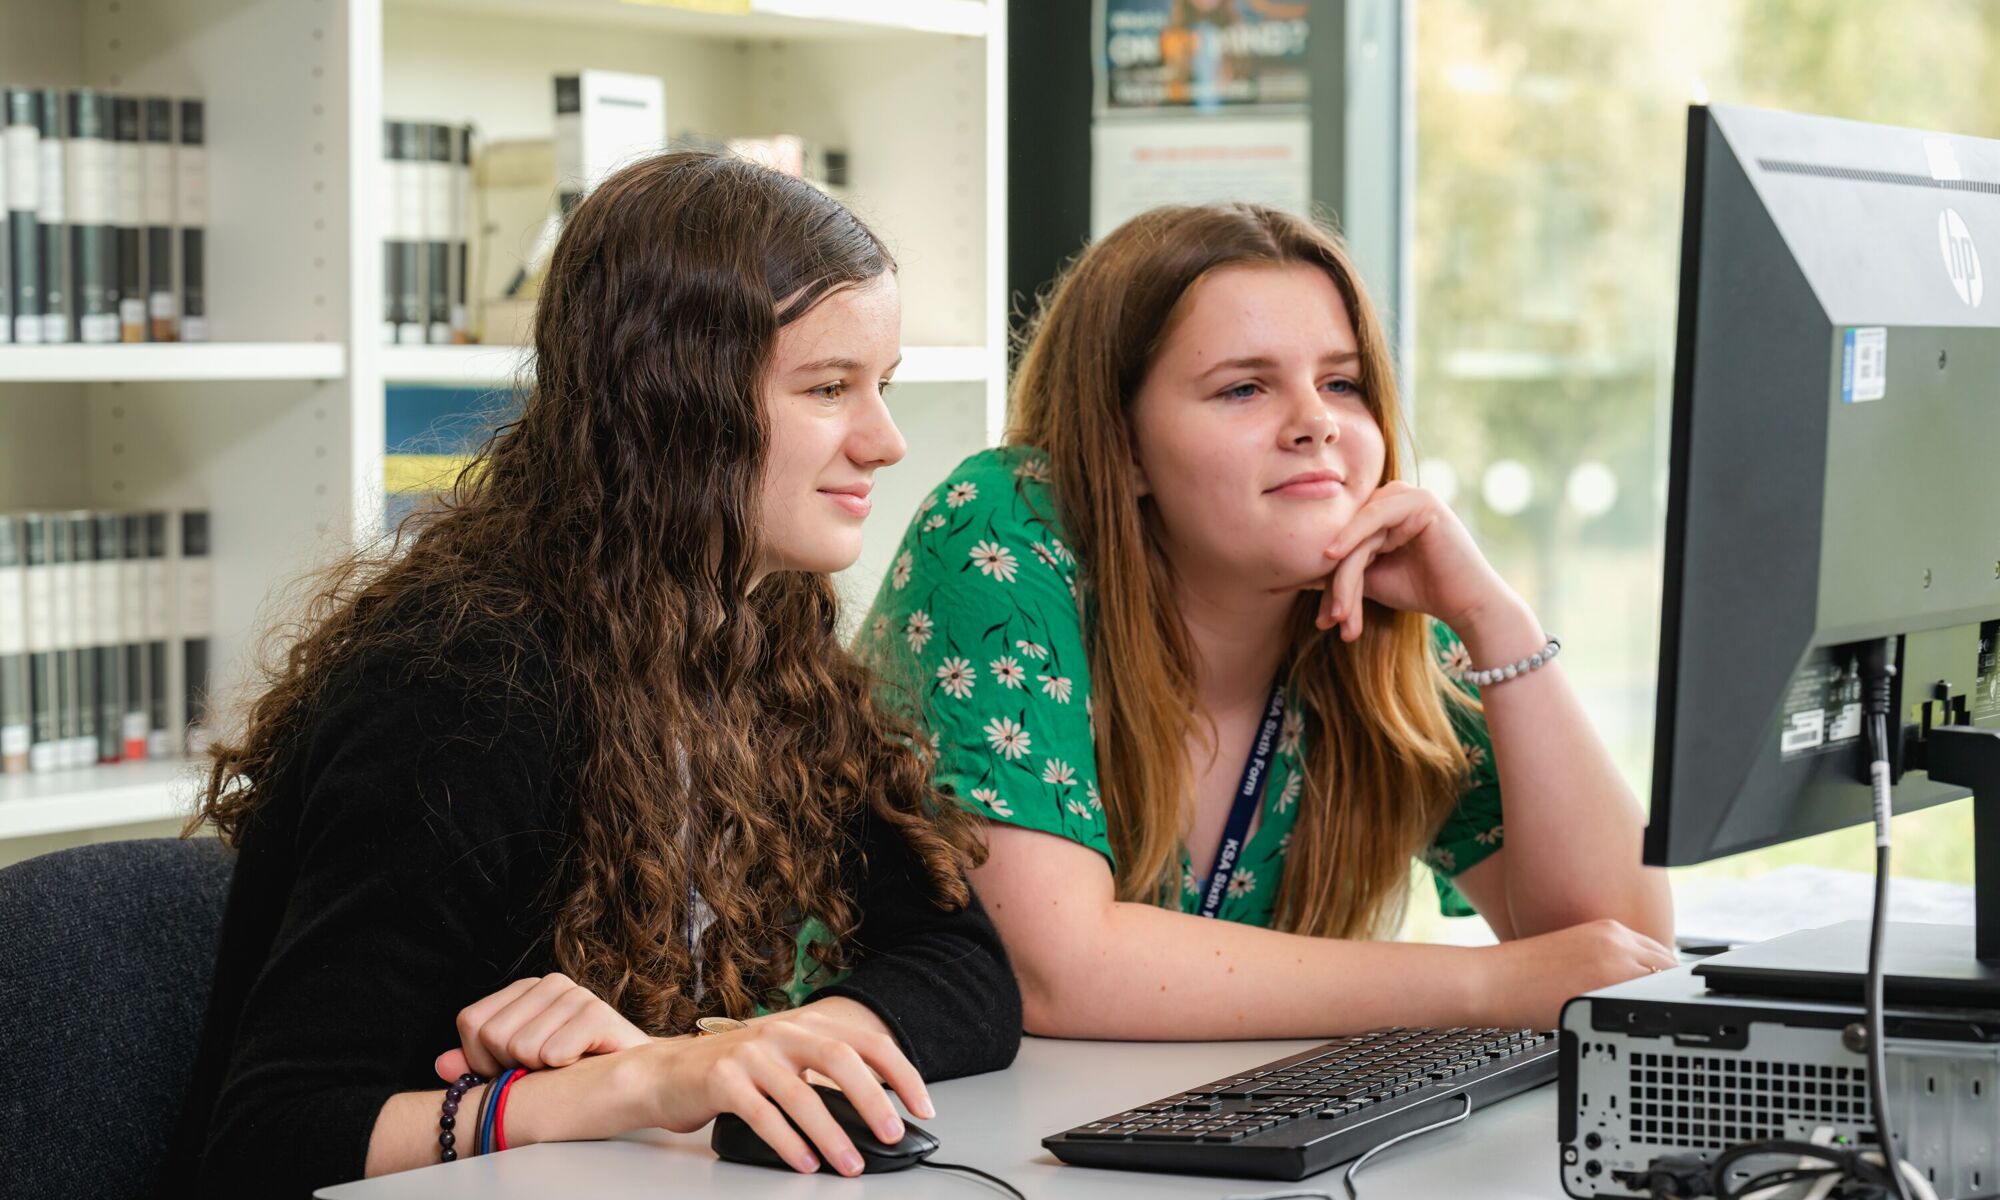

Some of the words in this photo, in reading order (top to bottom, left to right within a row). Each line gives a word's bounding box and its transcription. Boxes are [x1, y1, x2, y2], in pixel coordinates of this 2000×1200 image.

[1941, 207, 1981, 308] hp
[1256, 719, 1278, 757] Sixth
[1243, 758, 1266, 796] Form
[1218, 838, 1239, 871] KSA
[1205, 872, 1228, 909] Sixth
